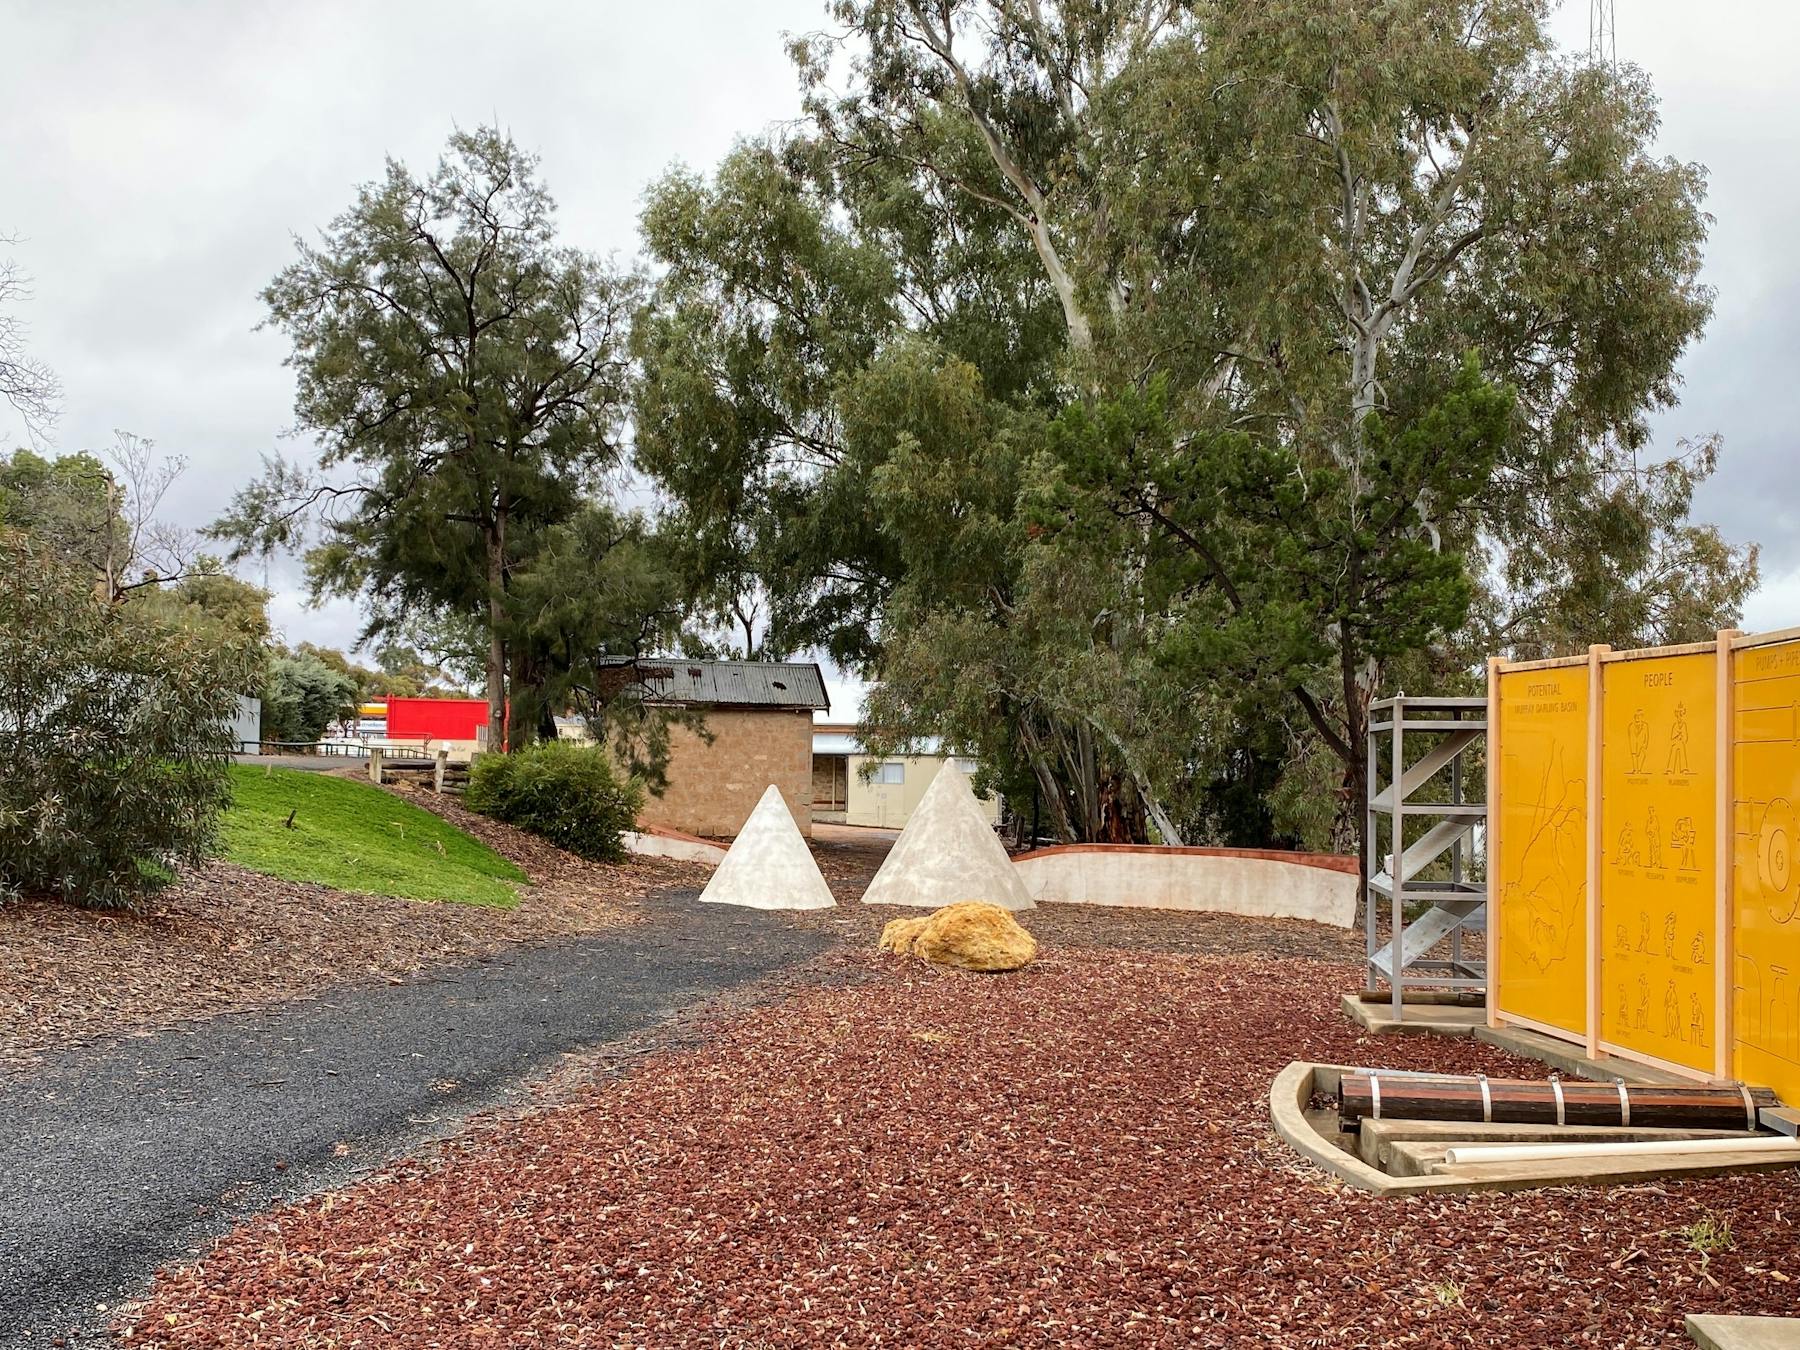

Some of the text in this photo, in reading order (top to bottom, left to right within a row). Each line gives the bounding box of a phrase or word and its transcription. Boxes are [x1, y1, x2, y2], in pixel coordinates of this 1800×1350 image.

[1643, 672, 1673, 688] PEOPLE
[1527, 682, 1562, 697] POTENTIAL
[1560, 701, 1578, 713] BASIN
